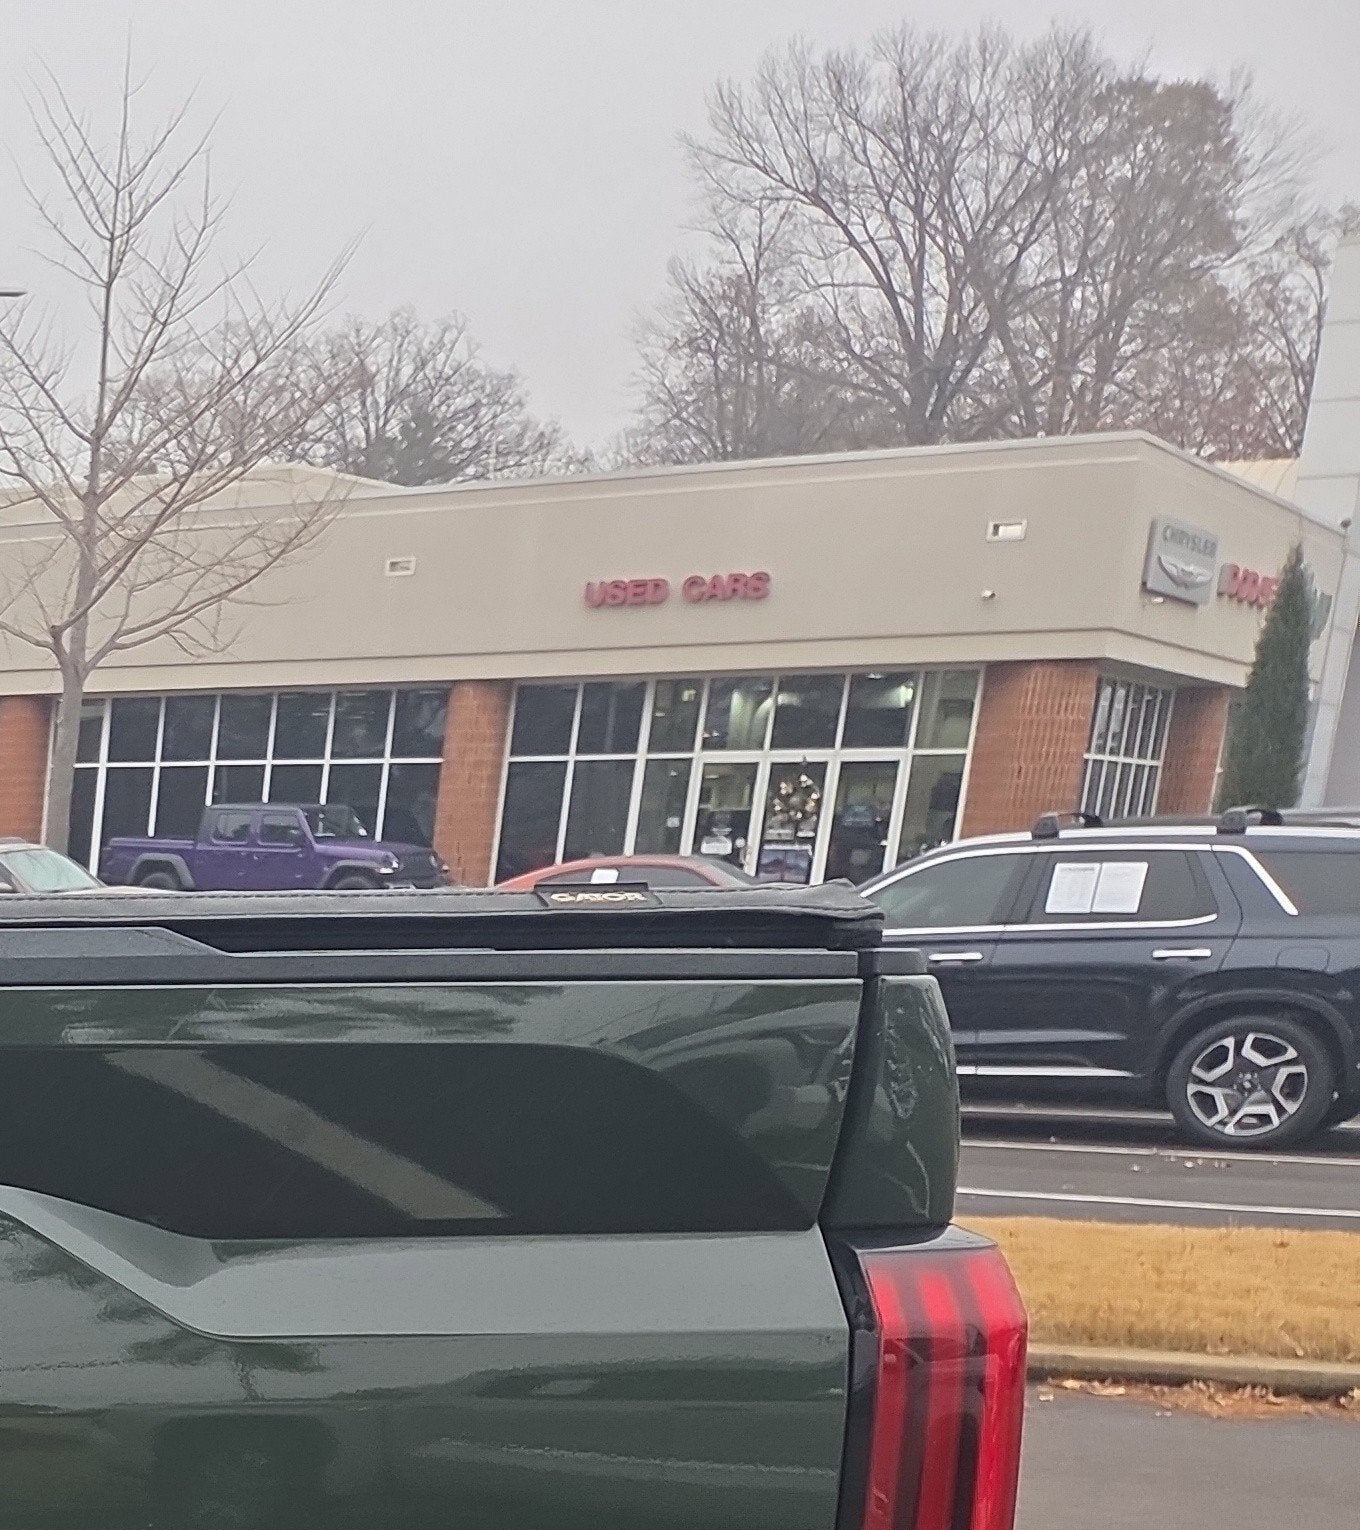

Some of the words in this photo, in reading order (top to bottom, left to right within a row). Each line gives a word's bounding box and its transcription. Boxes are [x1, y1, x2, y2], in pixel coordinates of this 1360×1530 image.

[584, 578, 671, 609] USED
[681, 571, 771, 604] CARS
[550, 891, 649, 903] GATOR
